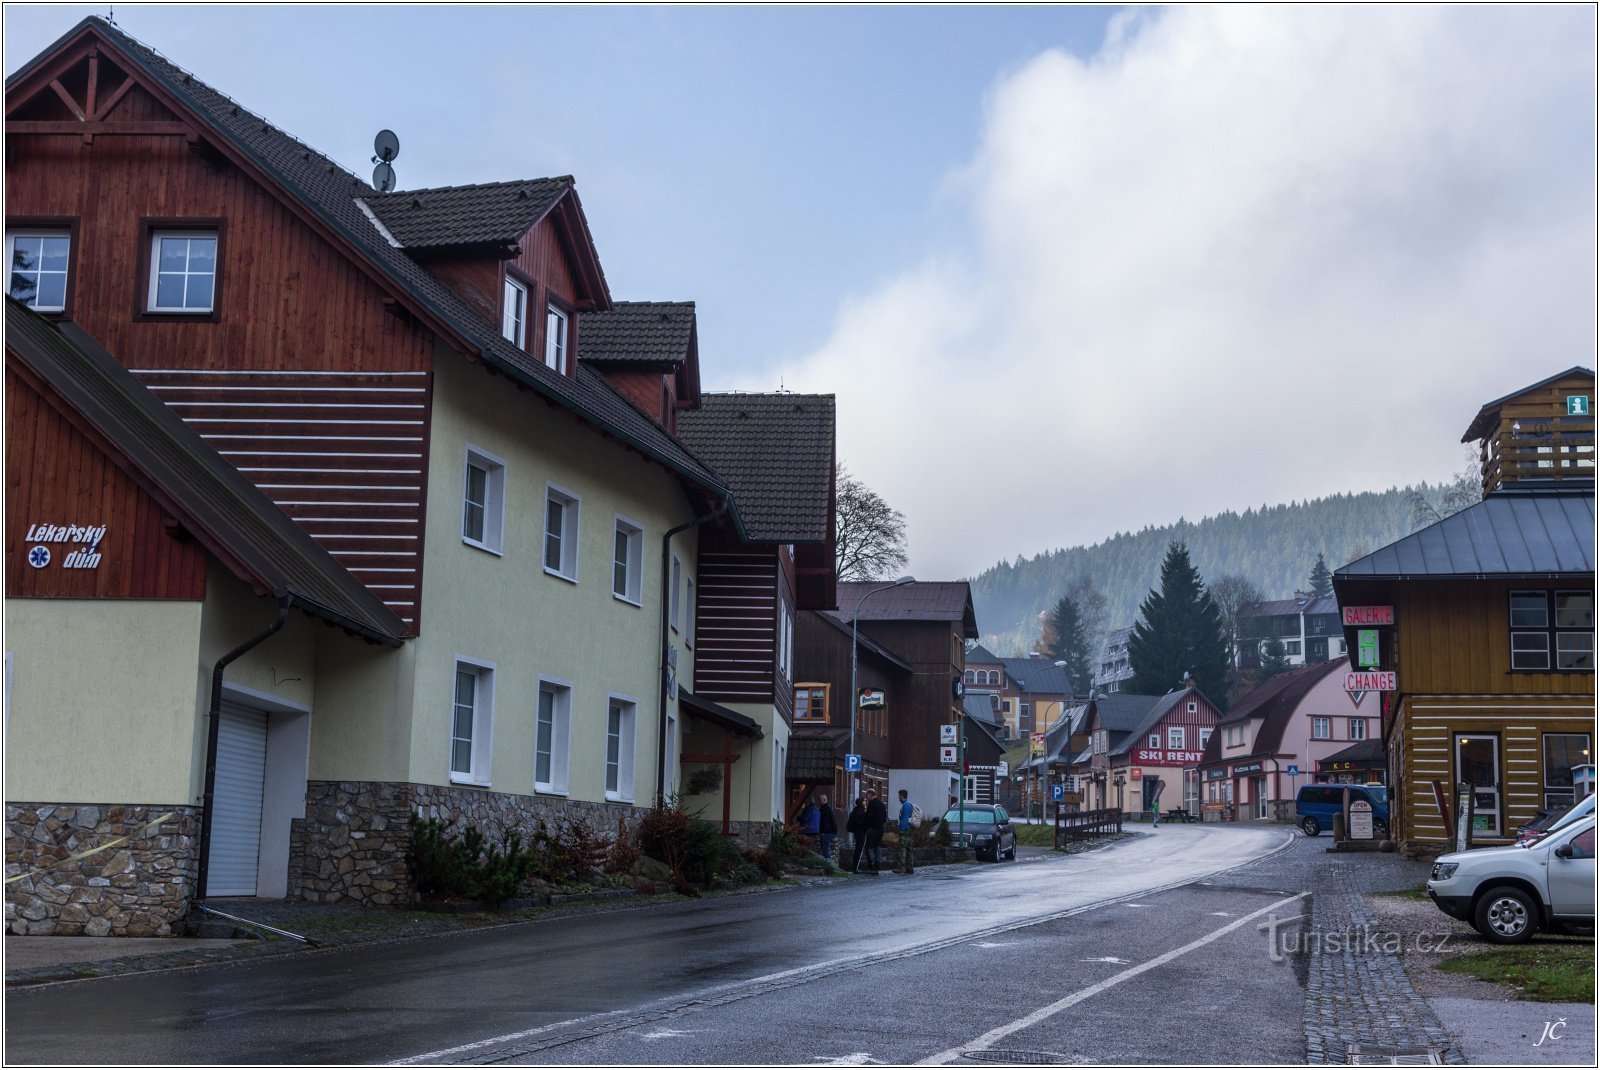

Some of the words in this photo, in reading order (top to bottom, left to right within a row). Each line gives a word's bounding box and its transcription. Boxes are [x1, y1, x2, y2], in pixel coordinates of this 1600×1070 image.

[25, 523, 106, 550] Lékařský
[63, 547, 102, 569] dům
[1345, 607, 1393, 625] GALERIE
[1347, 673, 1395, 691] CHANGE
[850, 756, 858, 769] P
[1139, 751, 1163, 760] SKI
[1167, 752, 1203, 762] RENT
[1054, 786, 1062, 799] P
